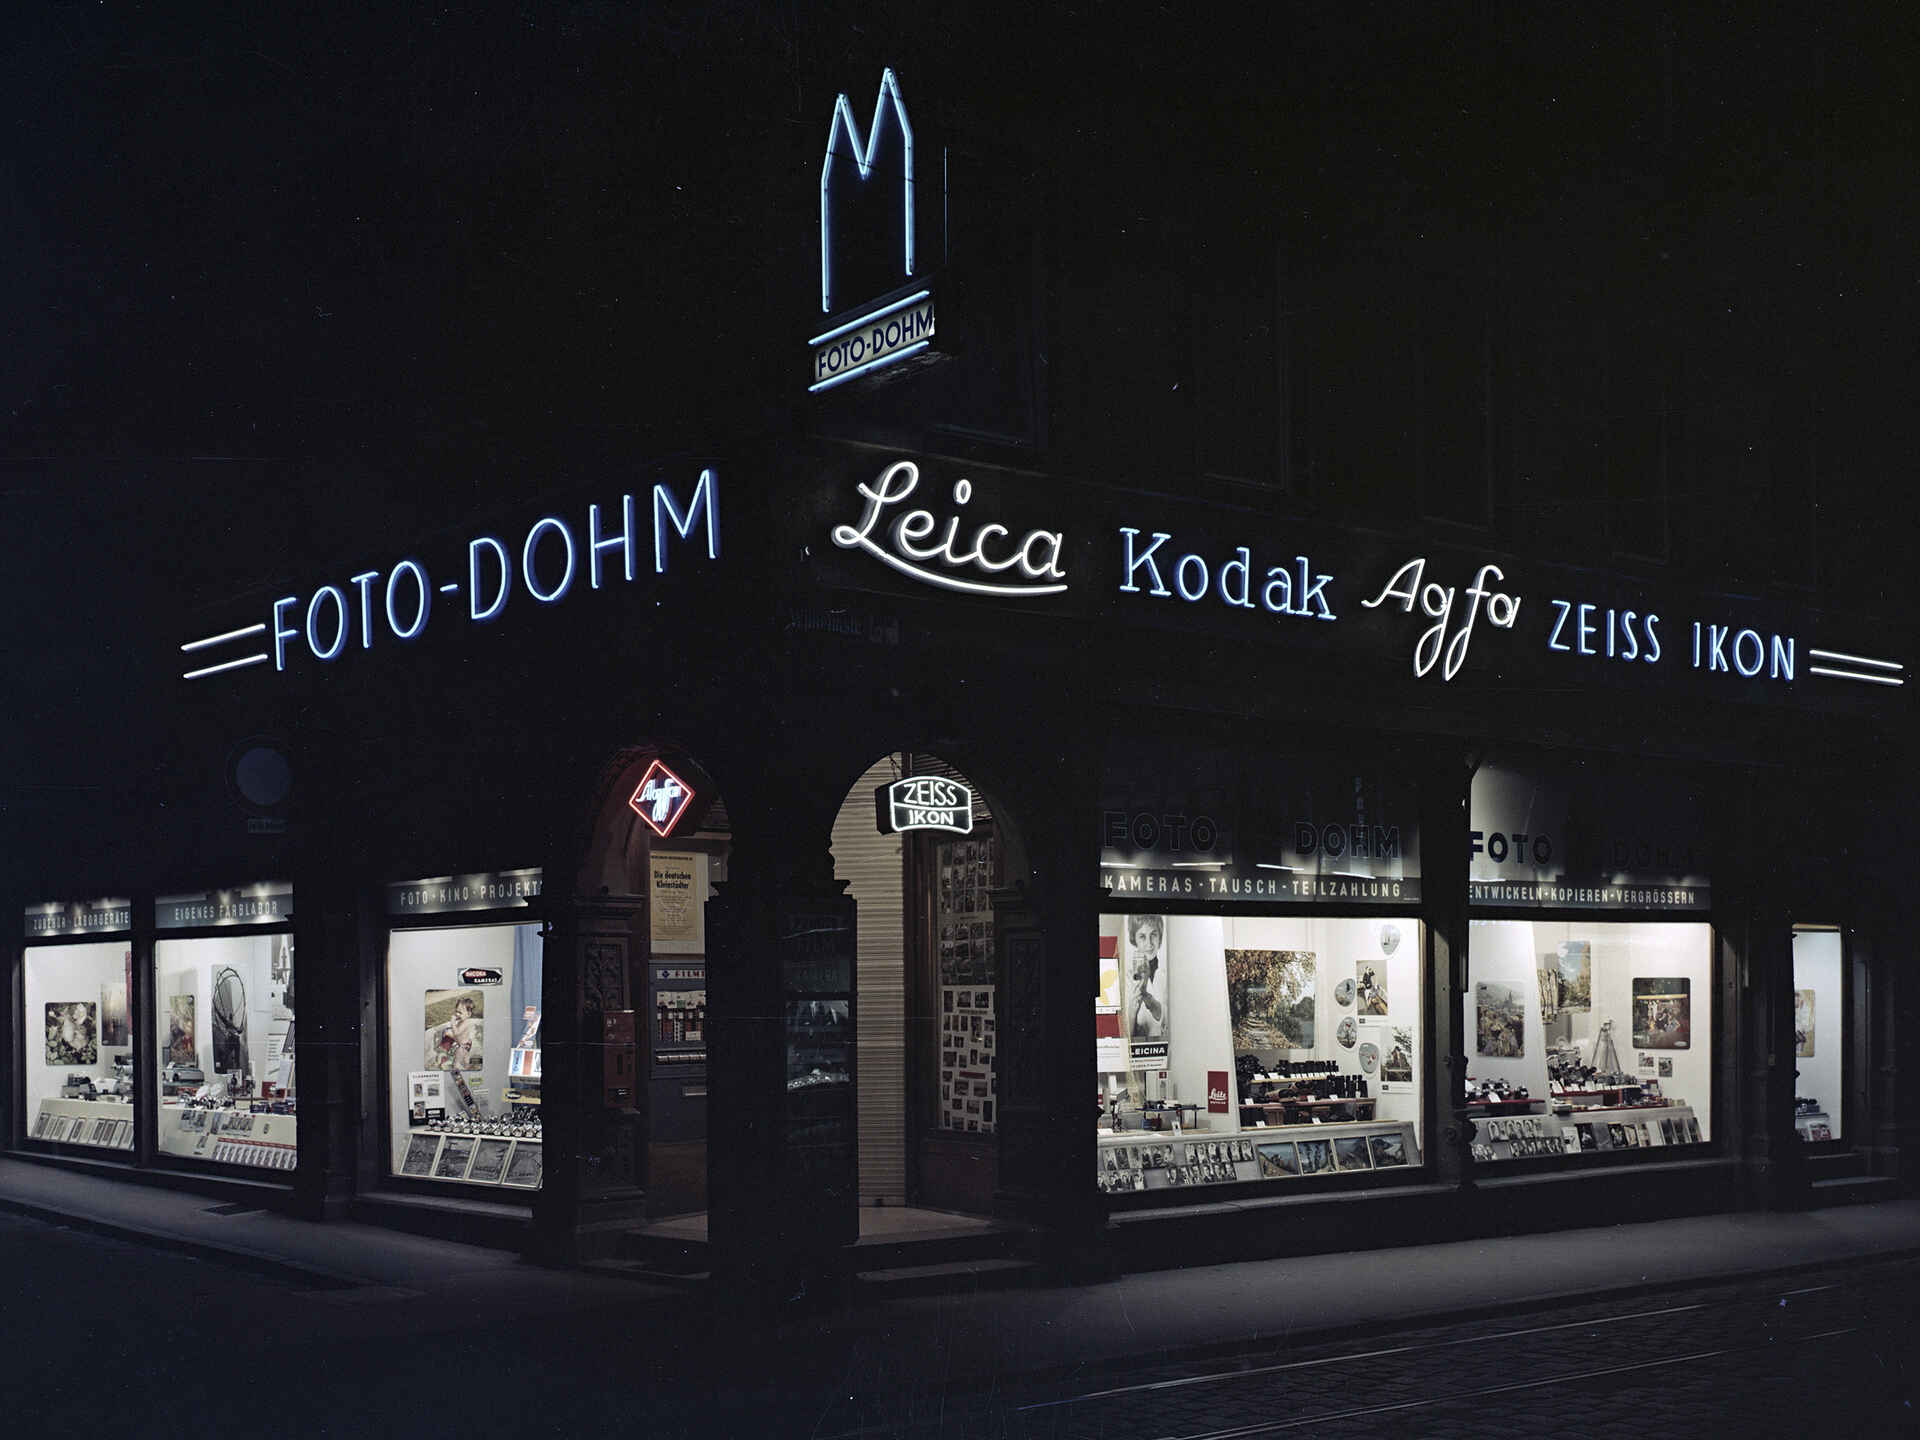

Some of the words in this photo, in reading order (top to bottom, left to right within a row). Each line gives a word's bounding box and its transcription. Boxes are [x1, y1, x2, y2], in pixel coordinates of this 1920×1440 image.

[818, 304, 933, 377] FOTO-DOHM
[832, 461, 1068, 595] Leica
[273, 469, 718, 671] FOTO-DOHM
[1119, 527, 1337, 621] Kodak
[1361, 557, 1521, 682] Agfa
[1547, 599, 1661, 662] ZEISS
[1692, 621, 1796, 681] IKON
[635, 778, 682, 823] Agfa
[903, 781, 958, 806] ZEISS
[908, 809, 954, 826] IKON
[1104, 811, 1218, 853] FOTO
[1295, 822, 1401, 860] DOHM
[1470, 831, 1553, 864] FOTO
[400, 891, 429, 906] FOTO
[439, 886, 469, 903] KINO
[480, 880, 542, 899] PROJEKT
[1105, 874, 1192, 893] KAMERAS
[1209, 877, 1277, 895] TAUSCH
[1292, 880, 1401, 898] TEILZAHLUNG
[1550, 886, 1608, 904] KOPIEREN
[175, 905, 215, 921] EIGENES
